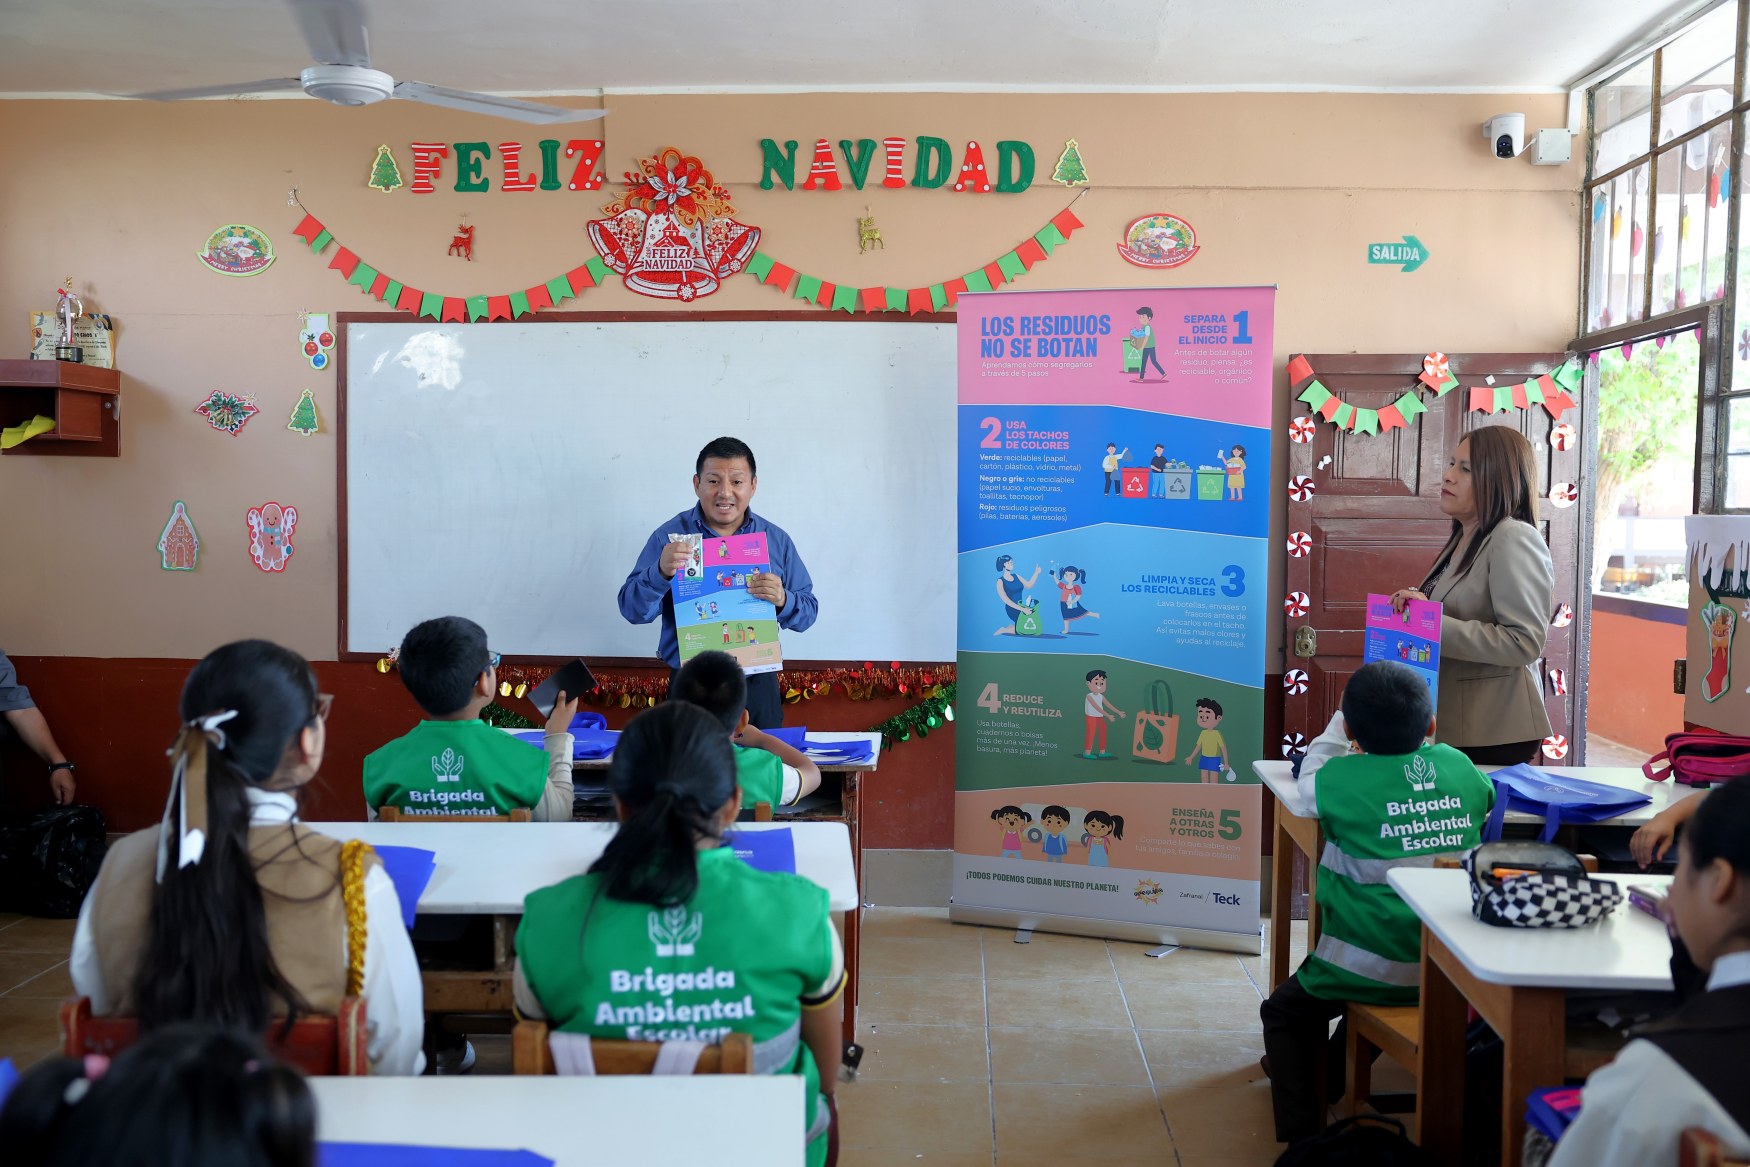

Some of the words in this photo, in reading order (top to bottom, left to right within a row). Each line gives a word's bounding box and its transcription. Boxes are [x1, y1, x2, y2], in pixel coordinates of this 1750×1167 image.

[411, 140, 604, 194] FELIZ
[759, 136, 1035, 193] NAVIDAD
[652, 249, 685, 258] FELIZ
[1373, 246, 1420, 261] SALIDA
[645, 260, 692, 269] NAVIDAD
[982, 316, 1014, 336] LOS
[1020, 314, 1111, 336] RESIDUOS
[1184, 315, 1226, 323] SEPARA
[1233, 311, 1252, 344] 1
[1192, 326, 1228, 334] DESDE
[1179, 336, 1191, 344] EL
[1194, 336, 1227, 344] INICIO
[981, 338, 1004, 358] NO
[1010, 338, 1031, 358] SE
[1037, 338, 1098, 358] BOTAN
[980, 417, 1002, 448] 2
[1006, 421, 1026, 429] USA
[1006, 431, 1025, 439] LOS
[1027, 431, 1069, 439] TACHOS
[1021, 441, 1070, 449] COLORES
[1005, 463, 1034, 471] plástico,
[1059, 464, 1081, 472] metal)
[980, 475, 1001, 483] Negro
[1009, 475, 1025, 483] gris:
[1030, 505, 1066, 513] peligrosos
[1032, 514, 1067, 522] aerosoles)
[1141, 575, 1178, 584] LIMPIA
[1188, 577, 1216, 586] SECA
[1221, 565, 1246, 597] 3
[1121, 584, 1142, 593] LOS
[1144, 585, 1216, 596] RECICLABLES
[1176, 600, 1208, 609] botellas,
[1209, 603, 1239, 611] envases
[1185, 610, 1212, 618] frascos
[1169, 627, 1190, 635] evitas
[1217, 630, 1239, 638] olores
[1177, 637, 1202, 645] ayudas
[977, 683, 1001, 713] 4
[1003, 694, 1043, 704] REDUCE
[1003, 706, 1009, 714] Y
[1011, 707, 1062, 717] REUTILIZA
[992, 720, 1021, 729] botellas,
[977, 729, 1013, 737] cuadernos
[977, 745, 1001, 753] basura,
[1020, 748, 1048, 756] planeta!
[409, 788, 484, 804] Brigada
[404, 806, 498, 816] Ambiental
[1387, 796, 1461, 816] Brigada
[1172, 808, 1214, 819] ENSEÑA
[1218, 809, 1242, 840] 5
[1179, 819, 1214, 828] OTRAS
[1381, 813, 1472, 838] Ambiental
[1170, 827, 1176, 835] Y
[1178, 828, 1214, 838] OTROS
[1402, 833, 1463, 851] Escolar
[966, 871, 991, 880] ¡TODOS
[993, 873, 1024, 883] PODEMOS
[1026, 877, 1052, 886] CUIDAR
[1054, 879, 1084, 889] NUESTRO
[1086, 883, 1119, 892] PLANETA!
[1213, 892, 1240, 905] Teck
[610, 966, 735, 996] Brigada
[595, 995, 755, 1025] Ambiental
